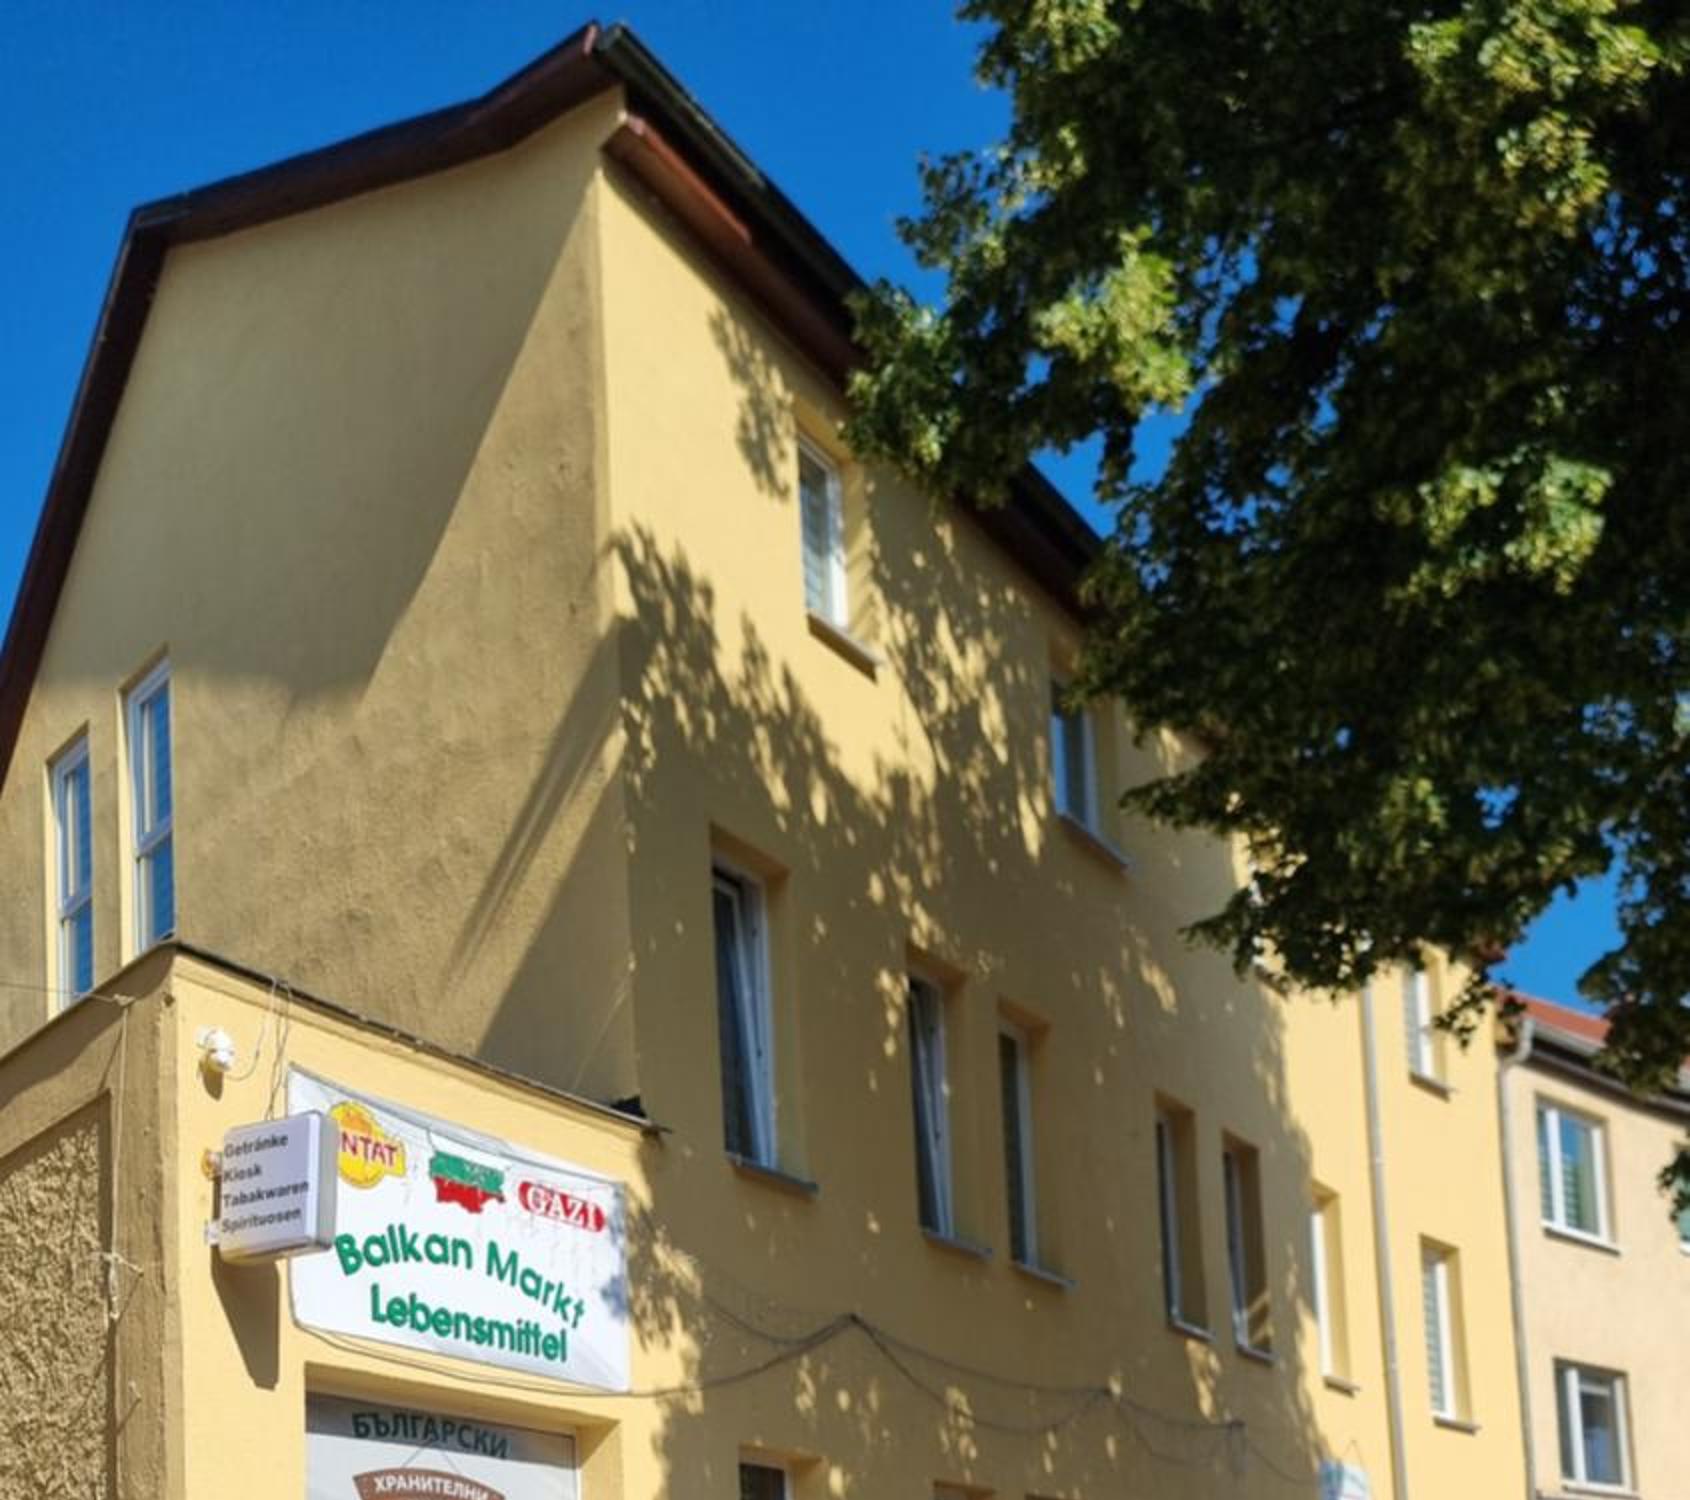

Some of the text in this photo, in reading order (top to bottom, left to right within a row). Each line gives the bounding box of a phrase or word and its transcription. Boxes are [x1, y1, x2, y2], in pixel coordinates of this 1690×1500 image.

[223, 1163, 262, 1182] Kiosk
[223, 1180, 309, 1208] Tabakwaren
[221, 1207, 302, 1233] Spirituosen
[526, 1187, 598, 1230] GAZI
[335, 1223, 585, 1329] Balkan Markt
[371, 1283, 568, 1363] Lebensmittel
[352, 1412, 508, 1459] БЪЛГАРСКИ
